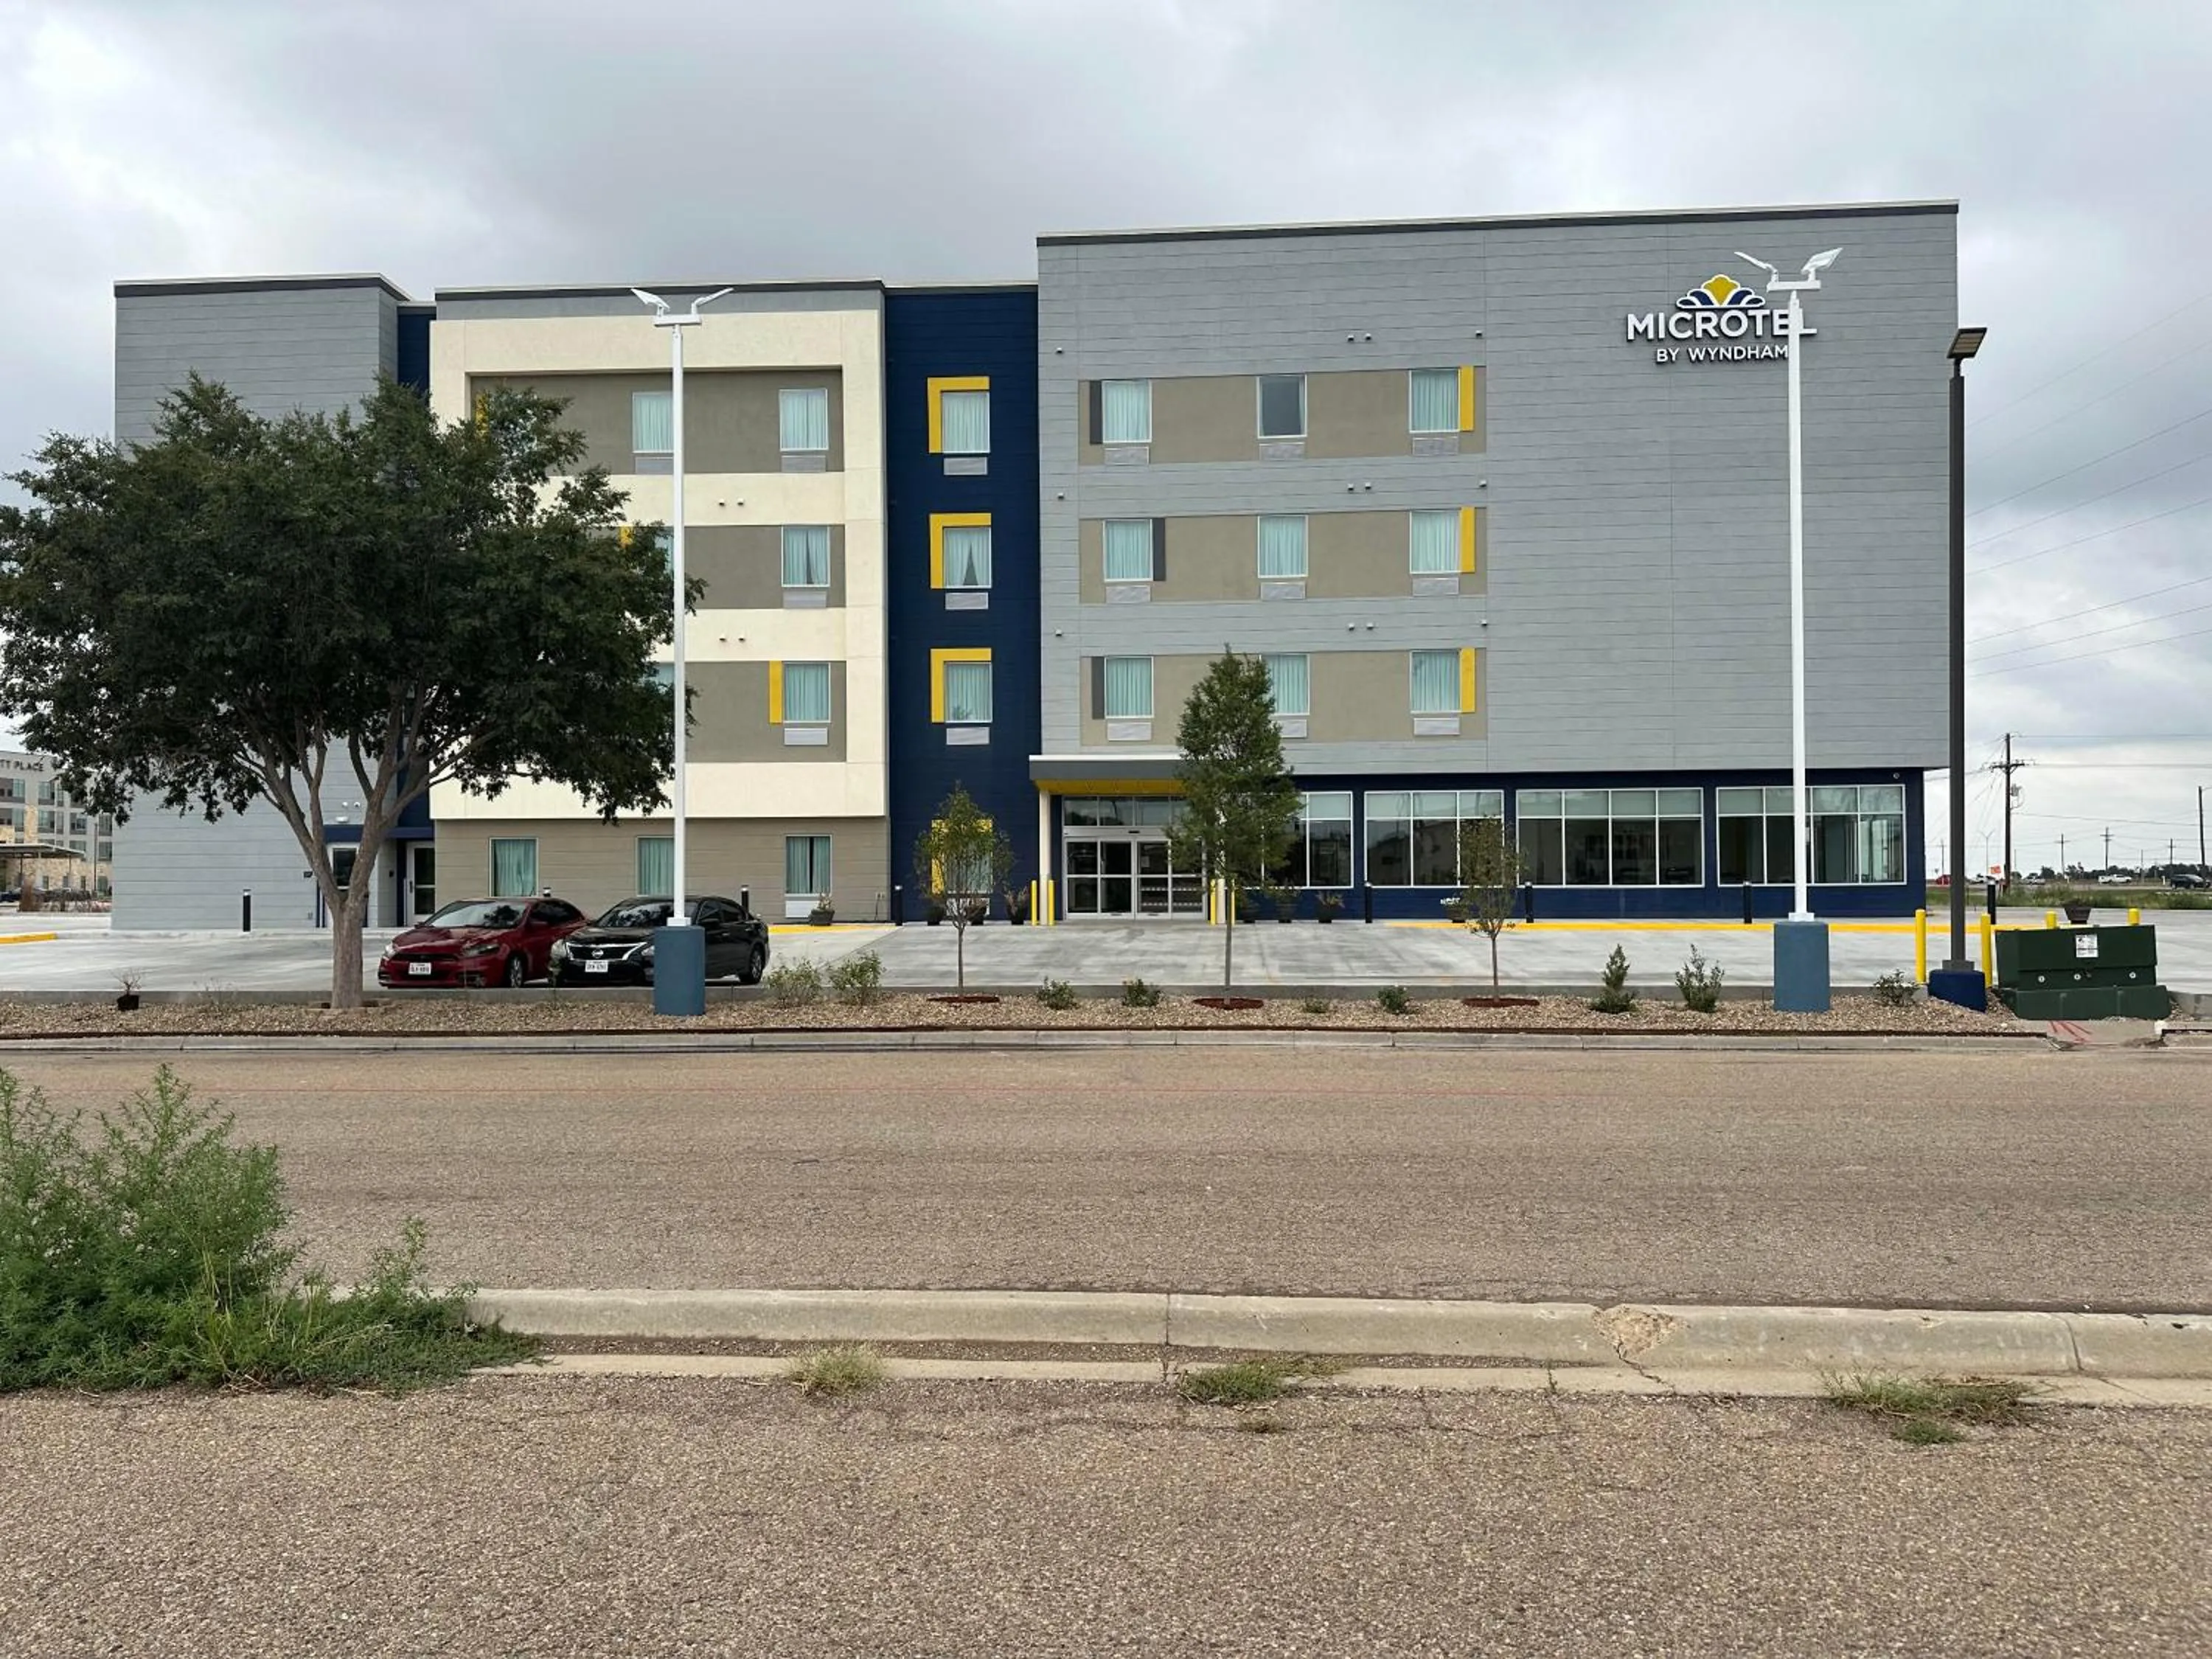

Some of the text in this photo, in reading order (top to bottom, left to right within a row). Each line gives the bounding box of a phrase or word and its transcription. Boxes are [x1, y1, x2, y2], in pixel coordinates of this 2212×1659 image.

[1627, 309, 1817, 340] MICROTEL
[1657, 344, 1788, 362] BY WYNDHAM
[14, 760, 44, 772] PLACE
